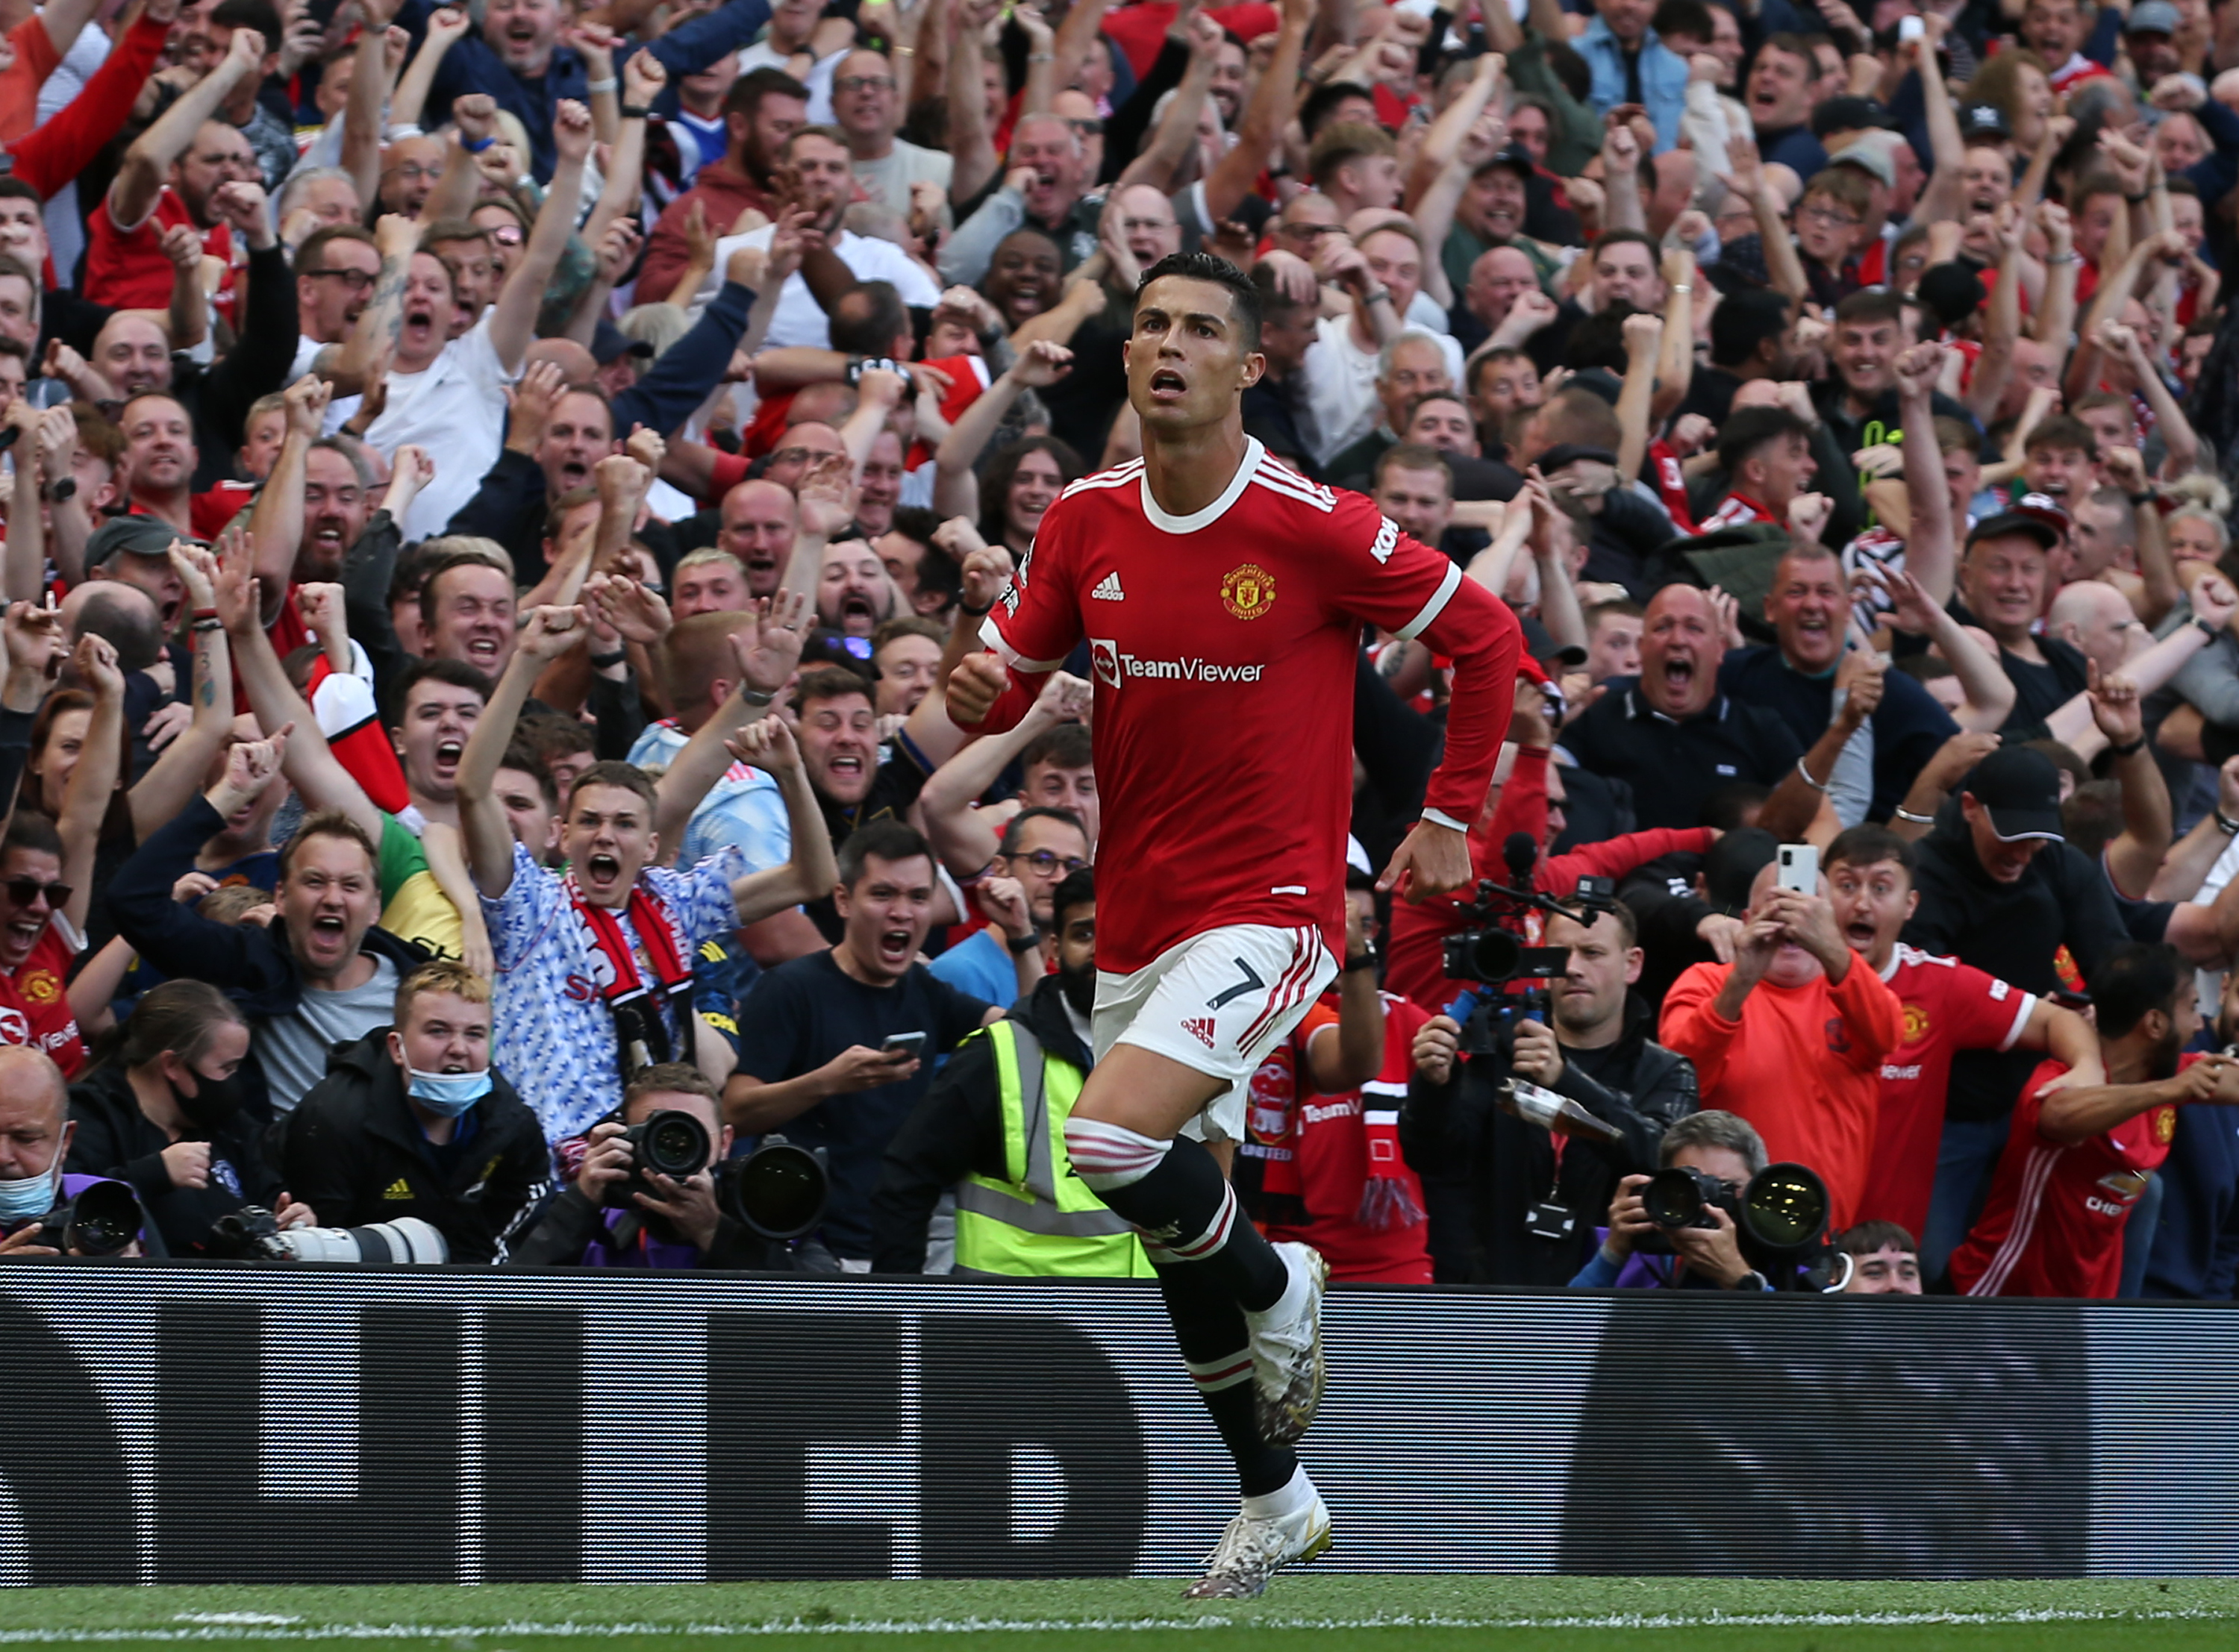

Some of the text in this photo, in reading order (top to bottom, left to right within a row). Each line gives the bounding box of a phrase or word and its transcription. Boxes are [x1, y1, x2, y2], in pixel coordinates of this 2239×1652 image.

[1091, 588, 1125, 601] adidas
[1119, 654, 1266, 683] TeamViewer
[1205, 956, 1266, 1011] 7
[1180, 1019, 1216, 1050] adidas
